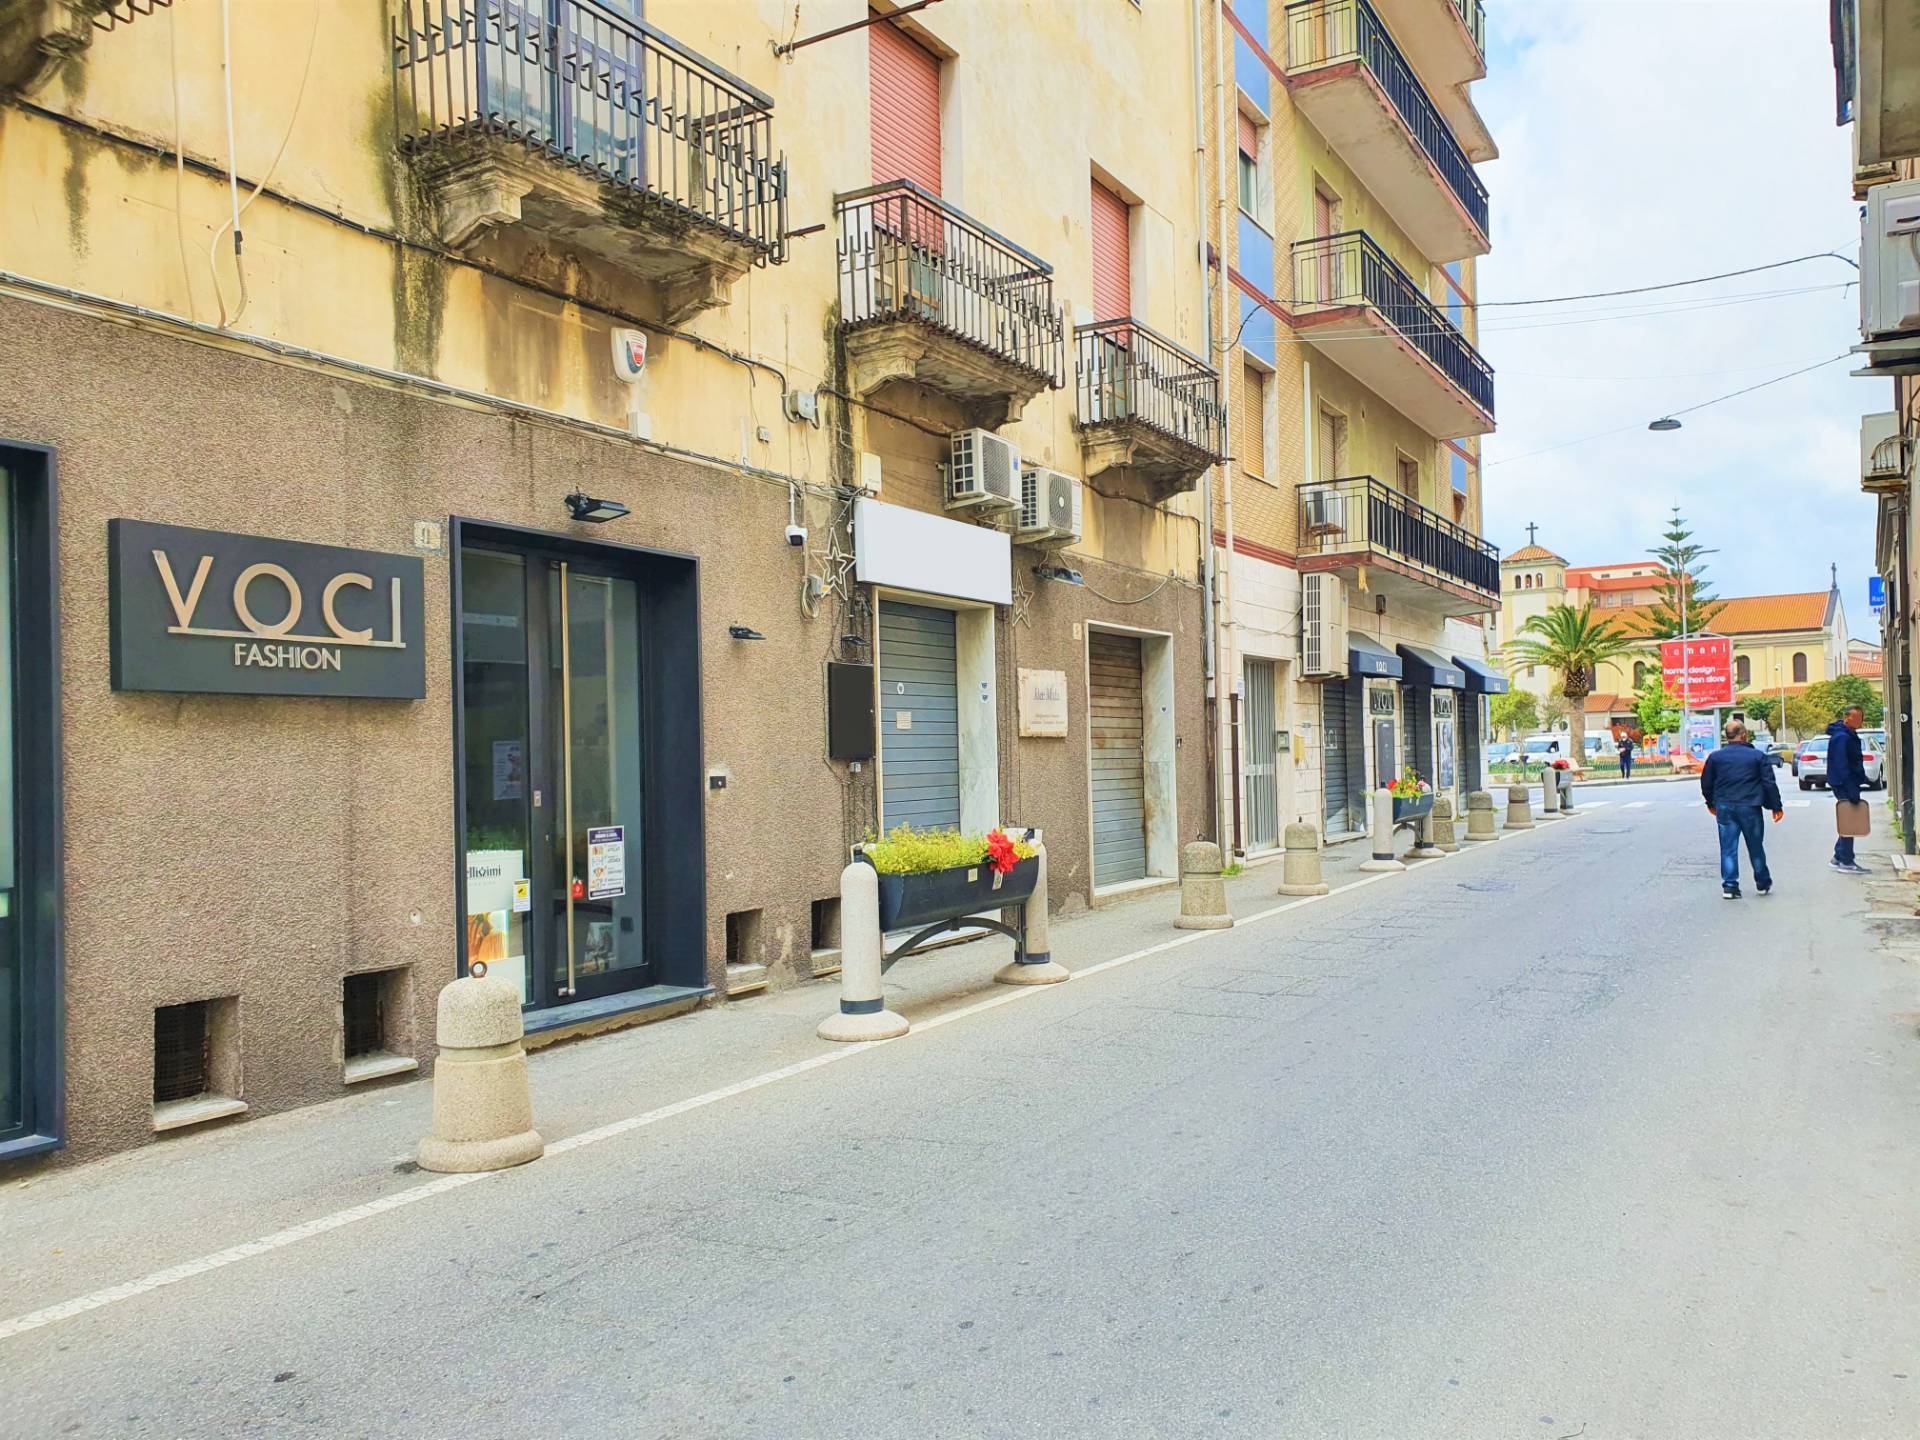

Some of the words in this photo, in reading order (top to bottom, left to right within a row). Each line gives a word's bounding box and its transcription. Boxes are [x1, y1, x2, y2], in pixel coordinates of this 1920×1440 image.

[152, 549, 404, 647] VOCI
[234, 643, 341, 670] FASHION
[1688, 666, 1715, 675] design
